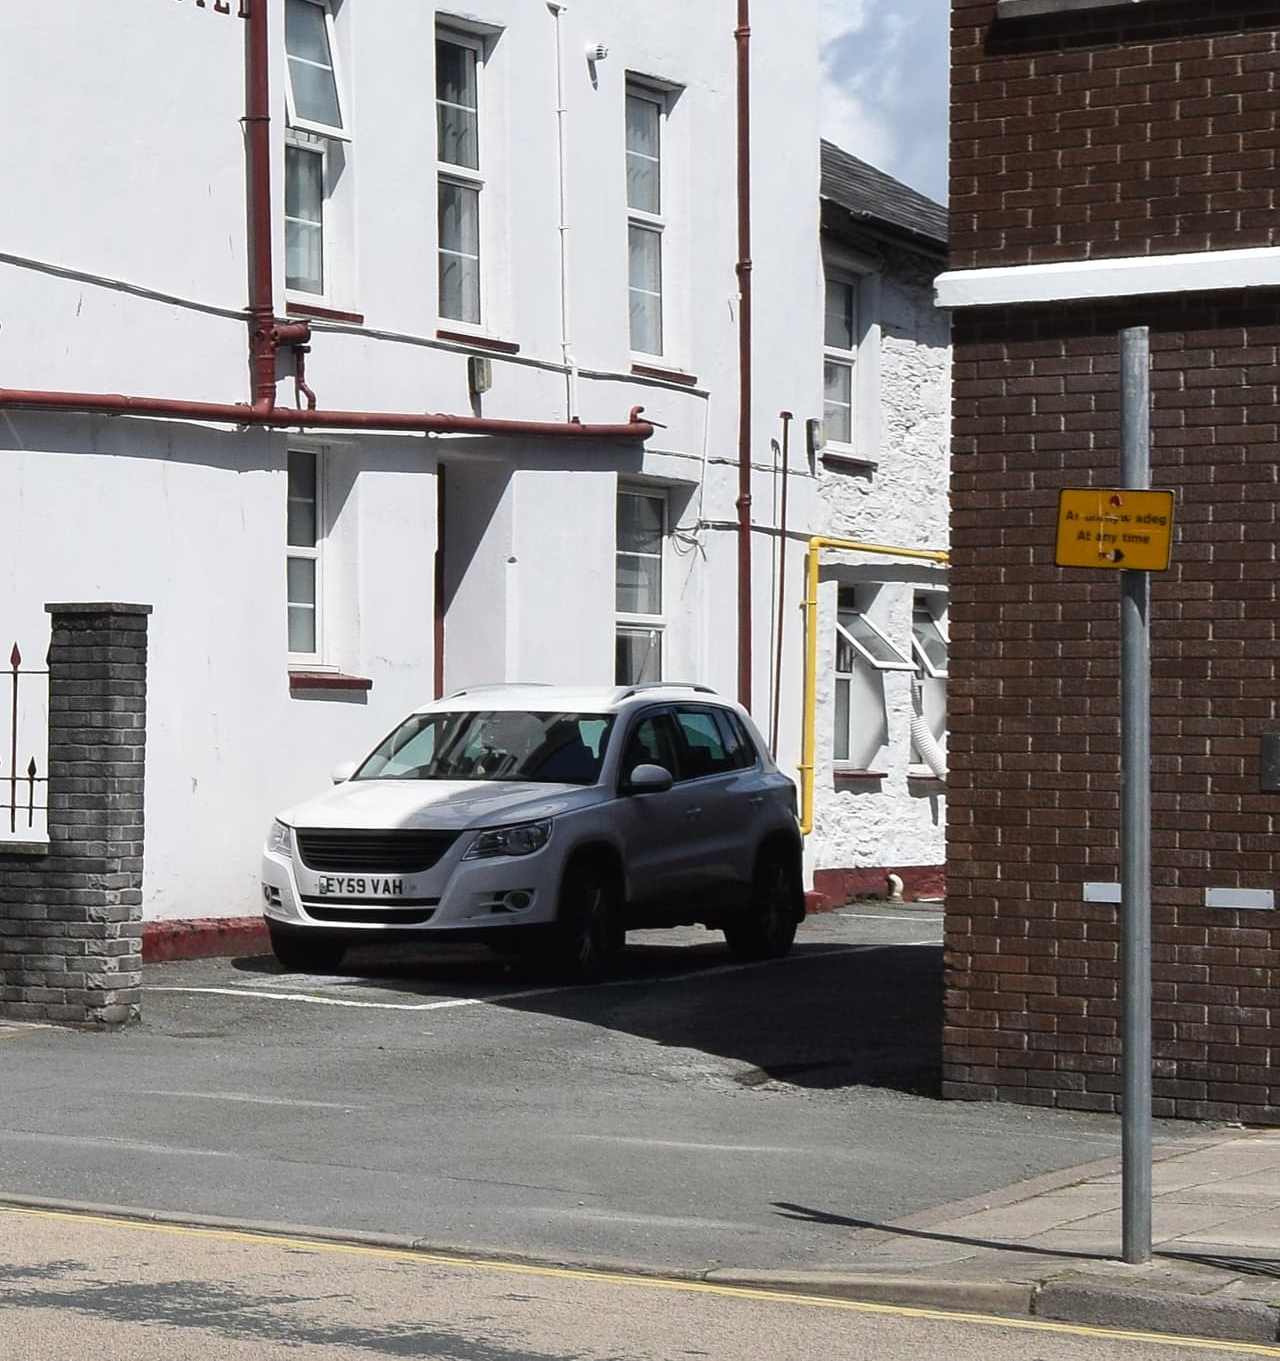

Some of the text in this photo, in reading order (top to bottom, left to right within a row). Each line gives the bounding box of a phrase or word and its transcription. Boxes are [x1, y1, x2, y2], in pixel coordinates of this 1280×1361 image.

[1077, 530, 1151, 544] At any time
[326, 877, 403, 895] EY59 VAH
